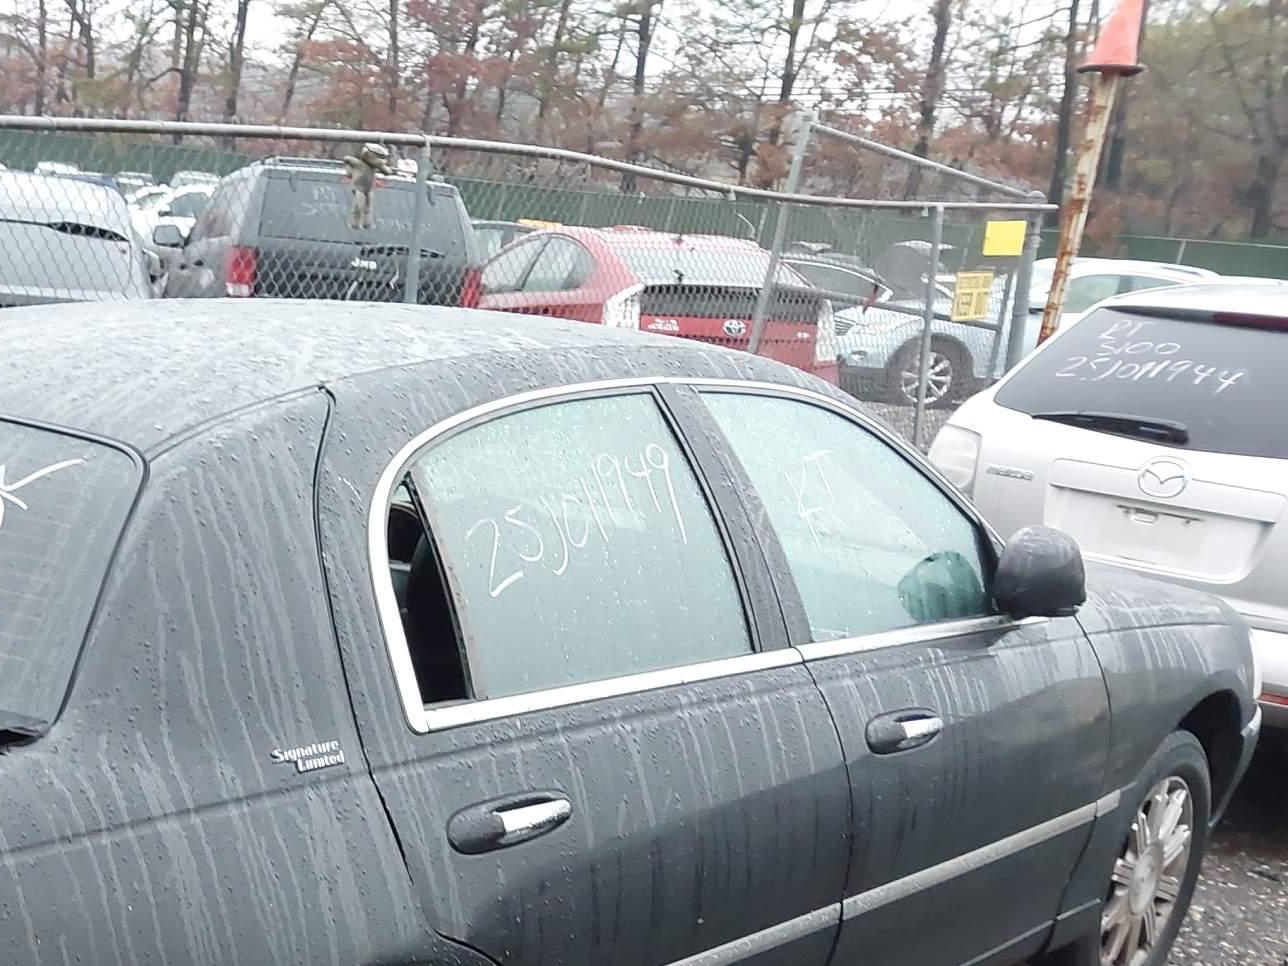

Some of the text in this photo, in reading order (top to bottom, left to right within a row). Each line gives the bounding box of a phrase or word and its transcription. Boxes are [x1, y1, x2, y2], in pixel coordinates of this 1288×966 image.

[465, 443, 687, 597] 25J011949
[272, 740, 339, 762] Signature
[297, 749, 345, 772] Limited
